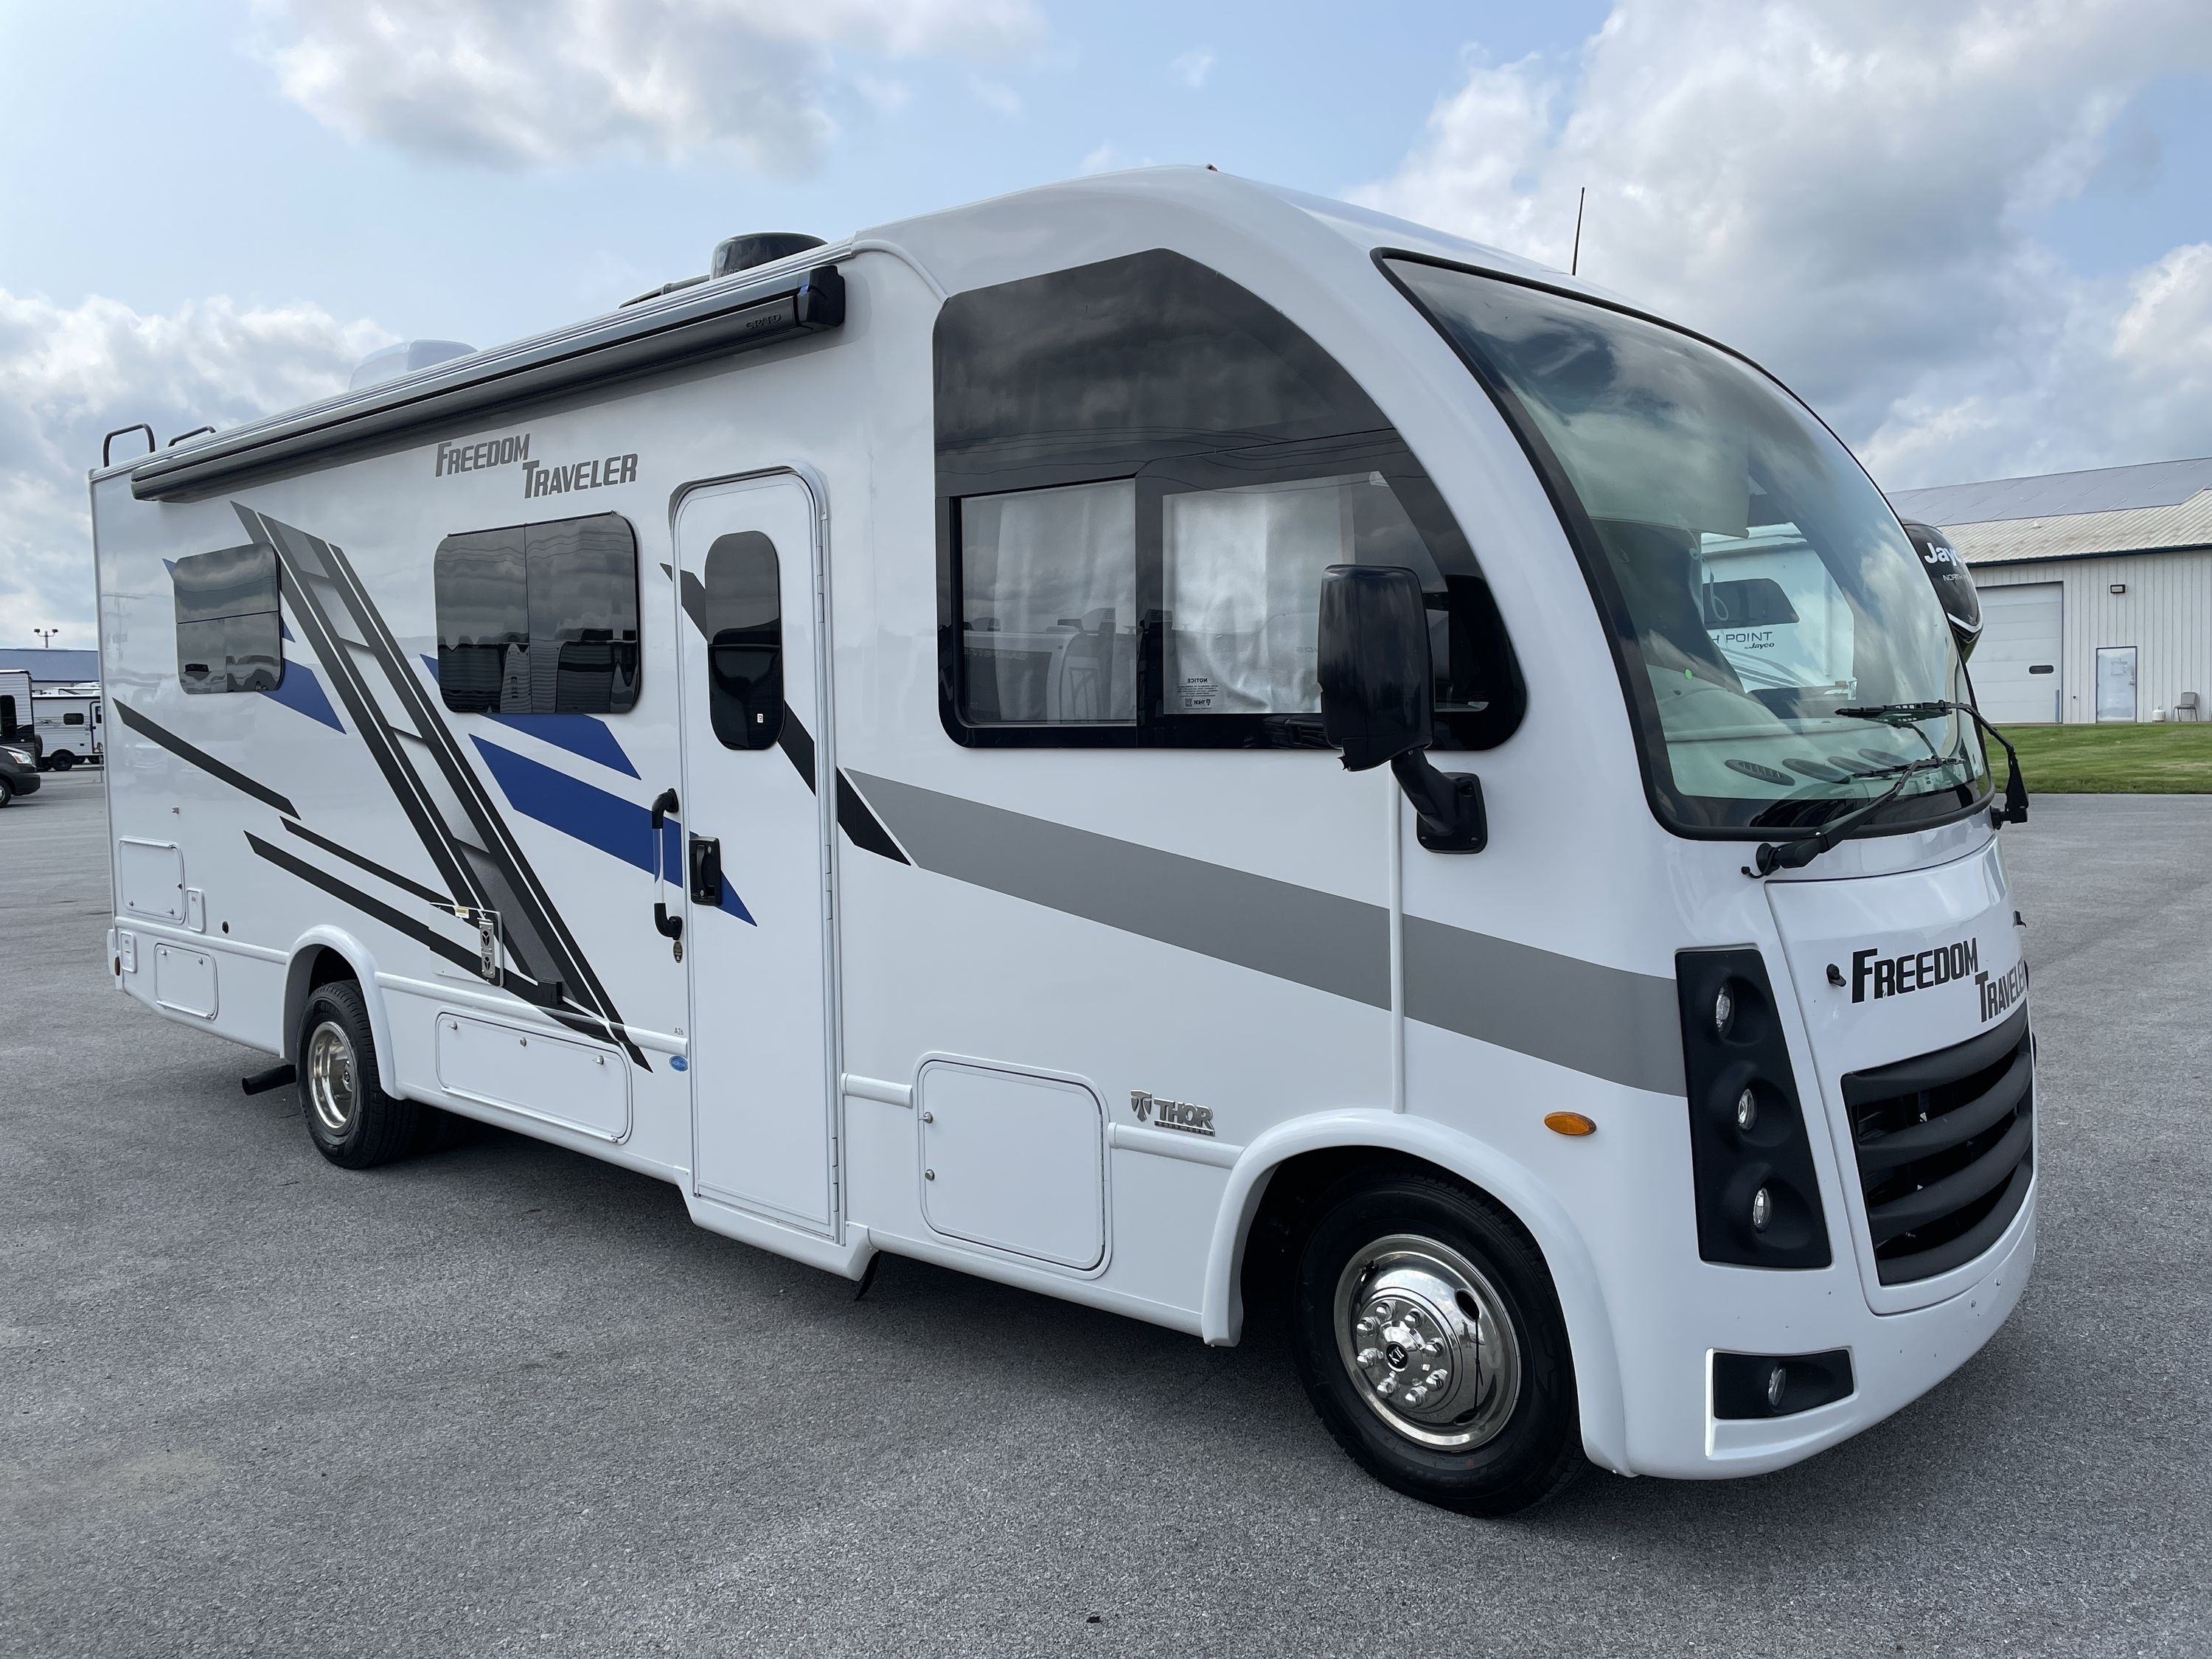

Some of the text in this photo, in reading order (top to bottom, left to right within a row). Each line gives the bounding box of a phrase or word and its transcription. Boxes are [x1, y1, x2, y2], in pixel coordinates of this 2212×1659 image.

[435, 433, 530, 478] FREEDOM
[522, 453, 638, 499] TRAVELER
[1924, 542, 1962, 566] Jayc
[1725, 631, 1773, 643] POINT
[1851, 937, 1978, 1004] FREEDOM
[1975, 956, 2025, 1023] TRAVELE
[1153, 1097, 1215, 1132] THOR
